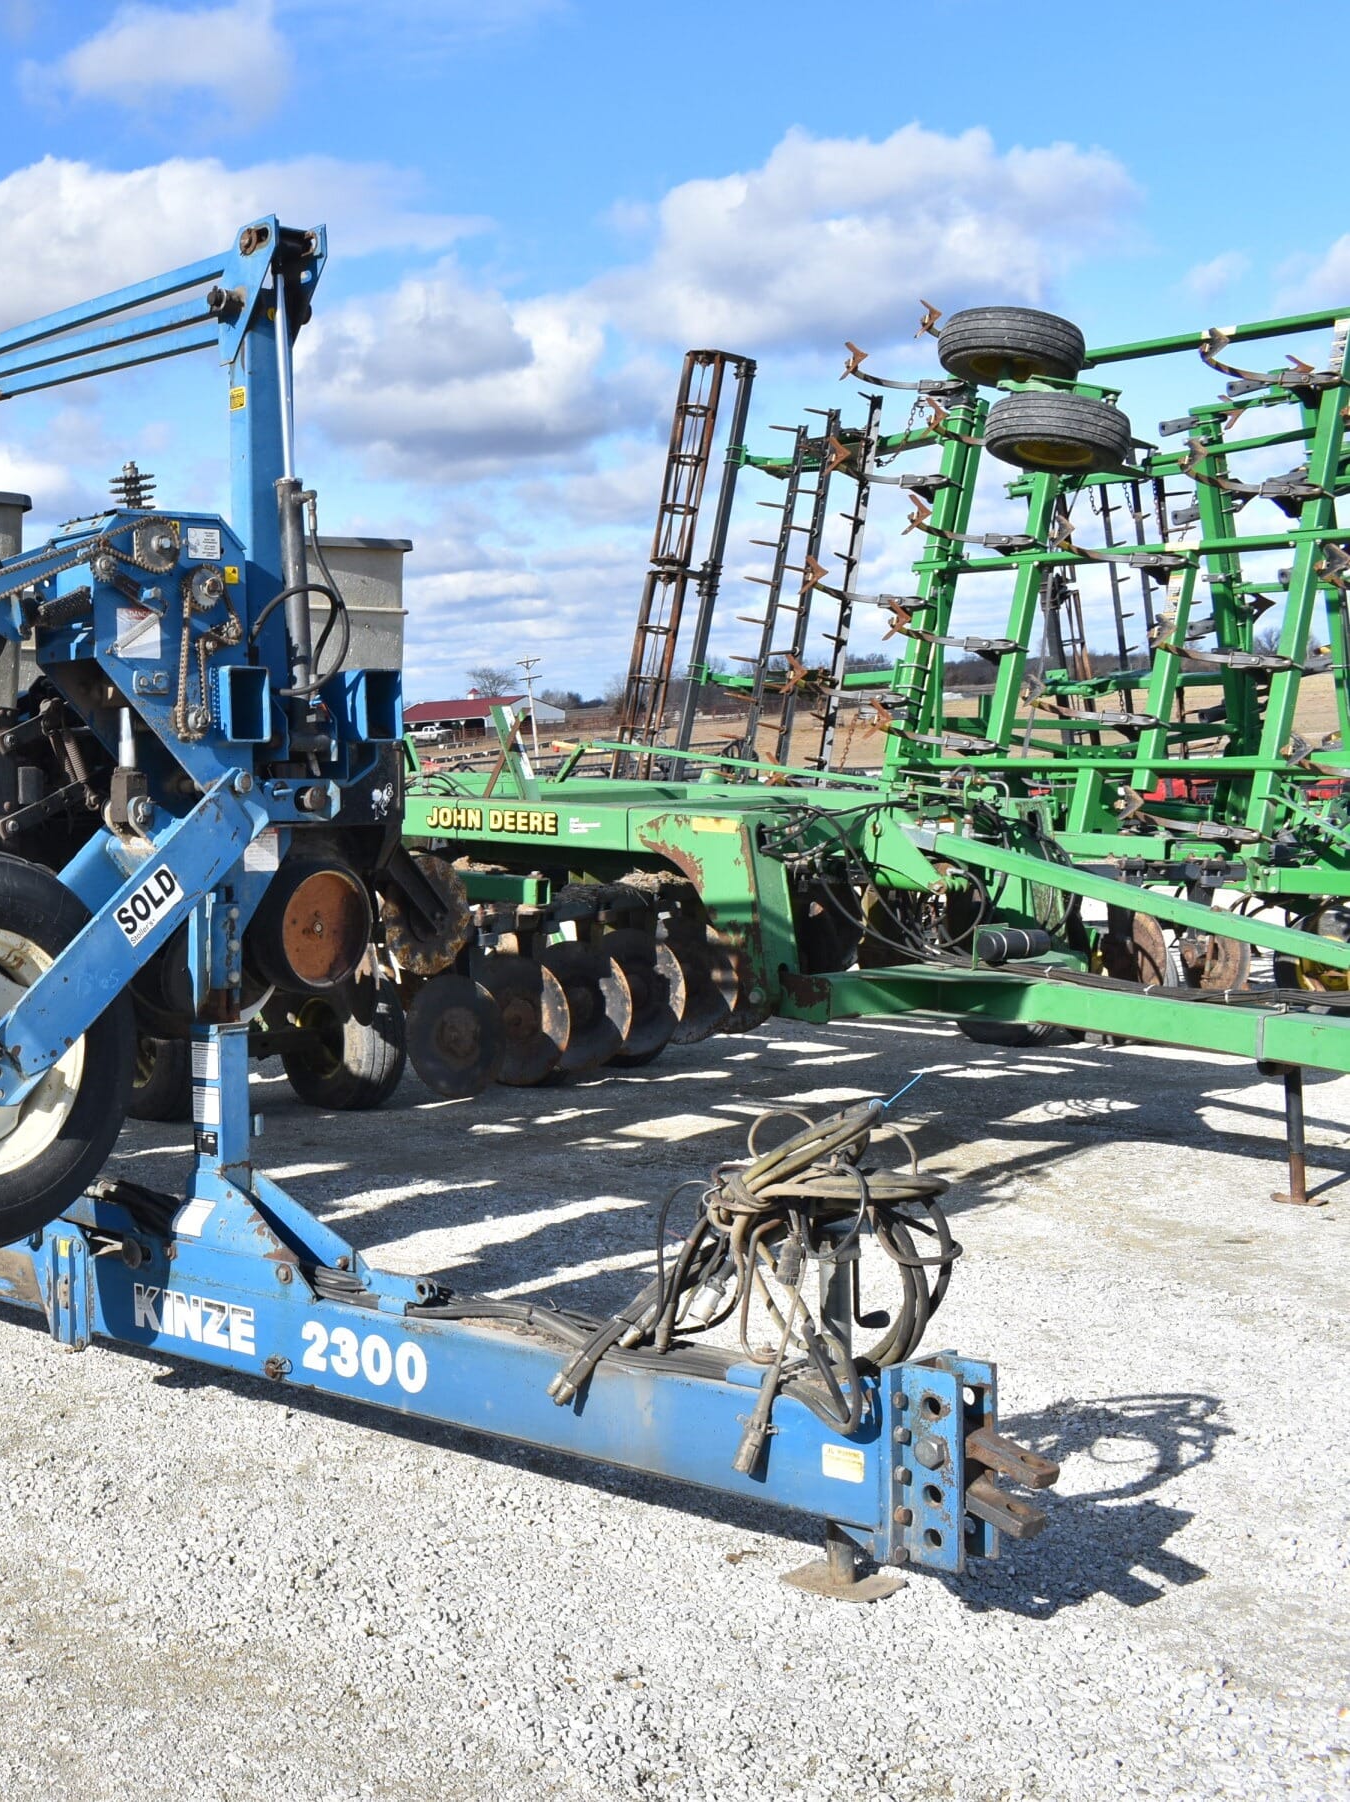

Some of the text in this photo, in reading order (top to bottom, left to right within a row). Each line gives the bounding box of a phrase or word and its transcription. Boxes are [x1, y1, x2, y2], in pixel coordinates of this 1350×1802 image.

[426, 806, 483, 831] JOHN
[489, 809, 558, 836] DEERE
[117, 869, 175, 934] SOLD
[134, 1283, 428, 1394] KINZE 2300
